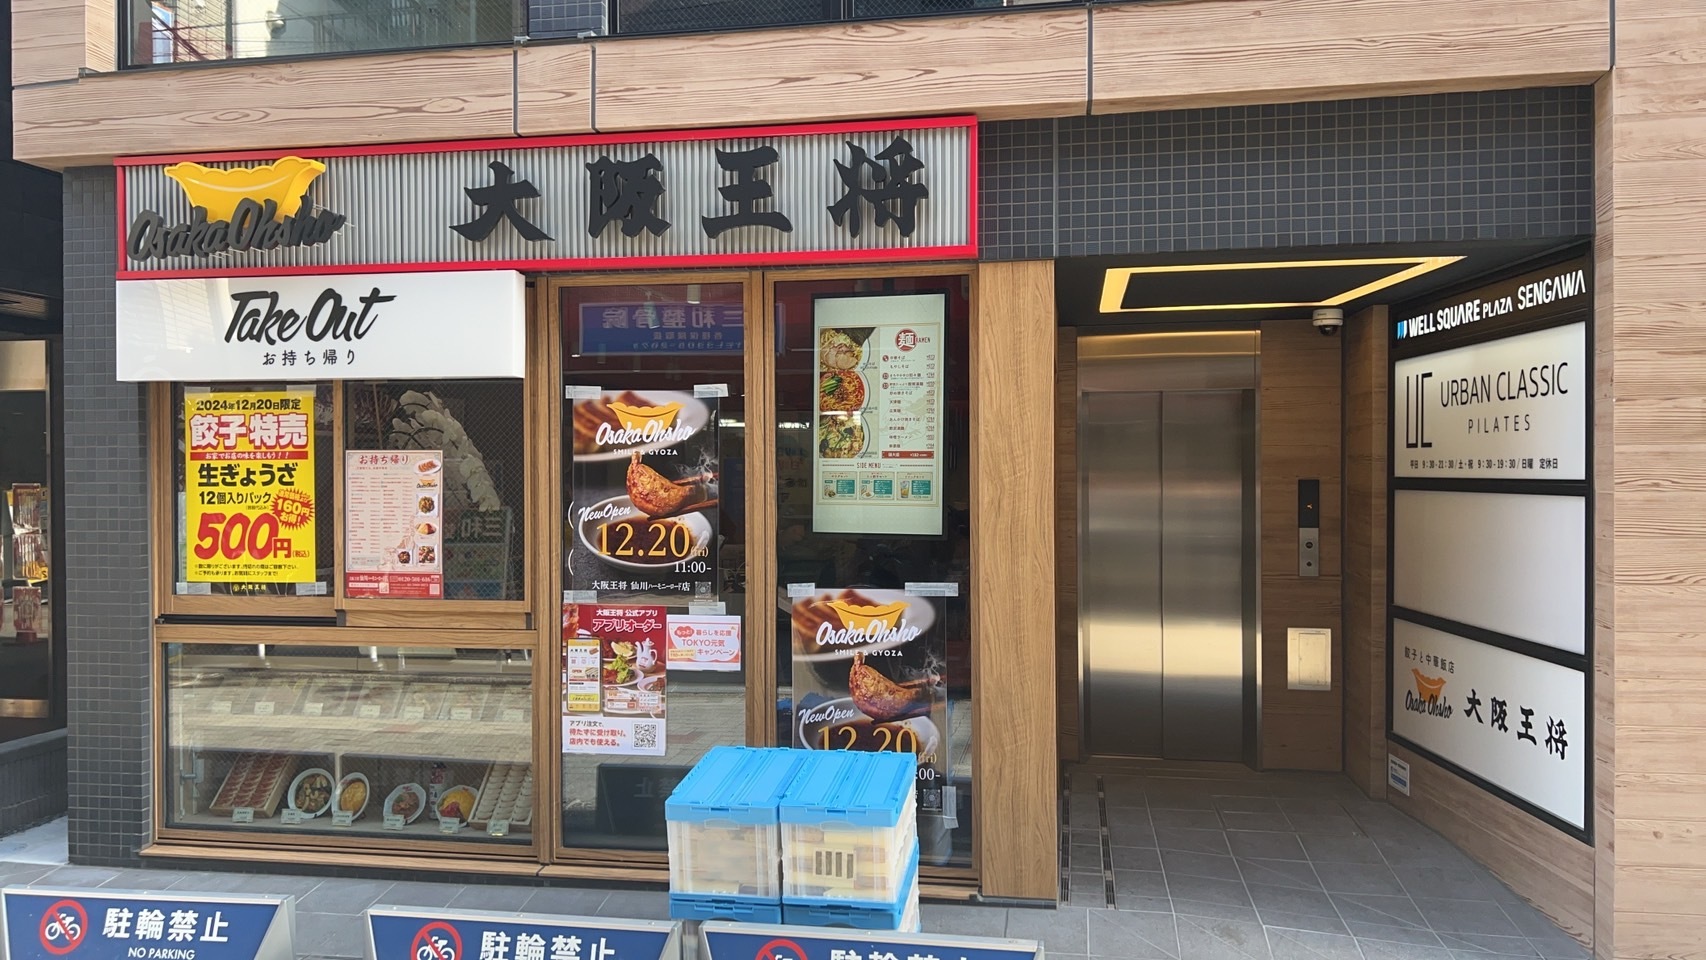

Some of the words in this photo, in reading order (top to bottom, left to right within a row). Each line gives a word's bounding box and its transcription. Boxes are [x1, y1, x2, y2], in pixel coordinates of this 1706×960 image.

[449, 135, 929, 242] 大阪王将
[127, 205, 229, 261] Osaka
[227, 194, 347, 250] Ohsho
[1409, 312, 1436, 337] WELL
[1437, 299, 1480, 330] SQUARE
[1483, 296, 1513, 319] PLAZA
[1518, 269, 1586, 310] SENGAWA
[225, 289, 307, 345] Take
[305, 287, 397, 342] Out
[262, 348, 356, 366] お持ち帰り
[1440, 374, 1491, 407] URBAN
[1496, 362, 1568, 401] CLASSIC
[196, 399, 301, 410] 2024年12月20日限定
[596, 421, 643, 446] Osaka
[642, 418, 697, 443] Ohsho
[1468, 414, 1531, 434] PILATES
[359, 454, 409, 465] お持ち帰り
[1410, 459, 1419, 469] 平日
[1539, 457, 1558, 470] 定休日
[198, 462, 298, 487] 生ぎょうざ
[199, 490, 272, 505] 12個入りパック
[277, 498, 310, 516] 160円
[578, 506, 604, 521] New
[603, 503, 631, 520] Open
[194, 512, 292, 560] 500円
[596, 522, 690, 557] 12.20
[691, 546, 708, 557] (fri)
[674, 561, 711, 573] 11:00-
[592, 580, 627, 590] 大阪王将
[592, 618, 662, 632] アプリオーダー
[816, 619, 865, 646] Osaka
[864, 617, 922, 643] Ohsho
[682, 639, 725, 647] TOKYO元気
[697, 648, 735, 656] キャンペーン
[872, 649, 903, 657] GYOZA
[1404, 646, 1455, 674] 餃子と中華飯店
[1405, 689, 1427, 714] Osaka
[1427, 695, 1454, 719] Ohsho
[798, 708, 826, 724] New
[825, 705, 855, 723] Open
[1463, 688, 1568, 761] 大阪王将
[569, 738, 620, 747] 店内でも使える。
[918, 753, 937, 763] (fri)
[102, 907, 230, 943] 駐輪禁止
[128, 947, 146, 959] NO
[148, 948, 195, 960] PARKING
[479, 931, 615, 960] 駐輪禁止
